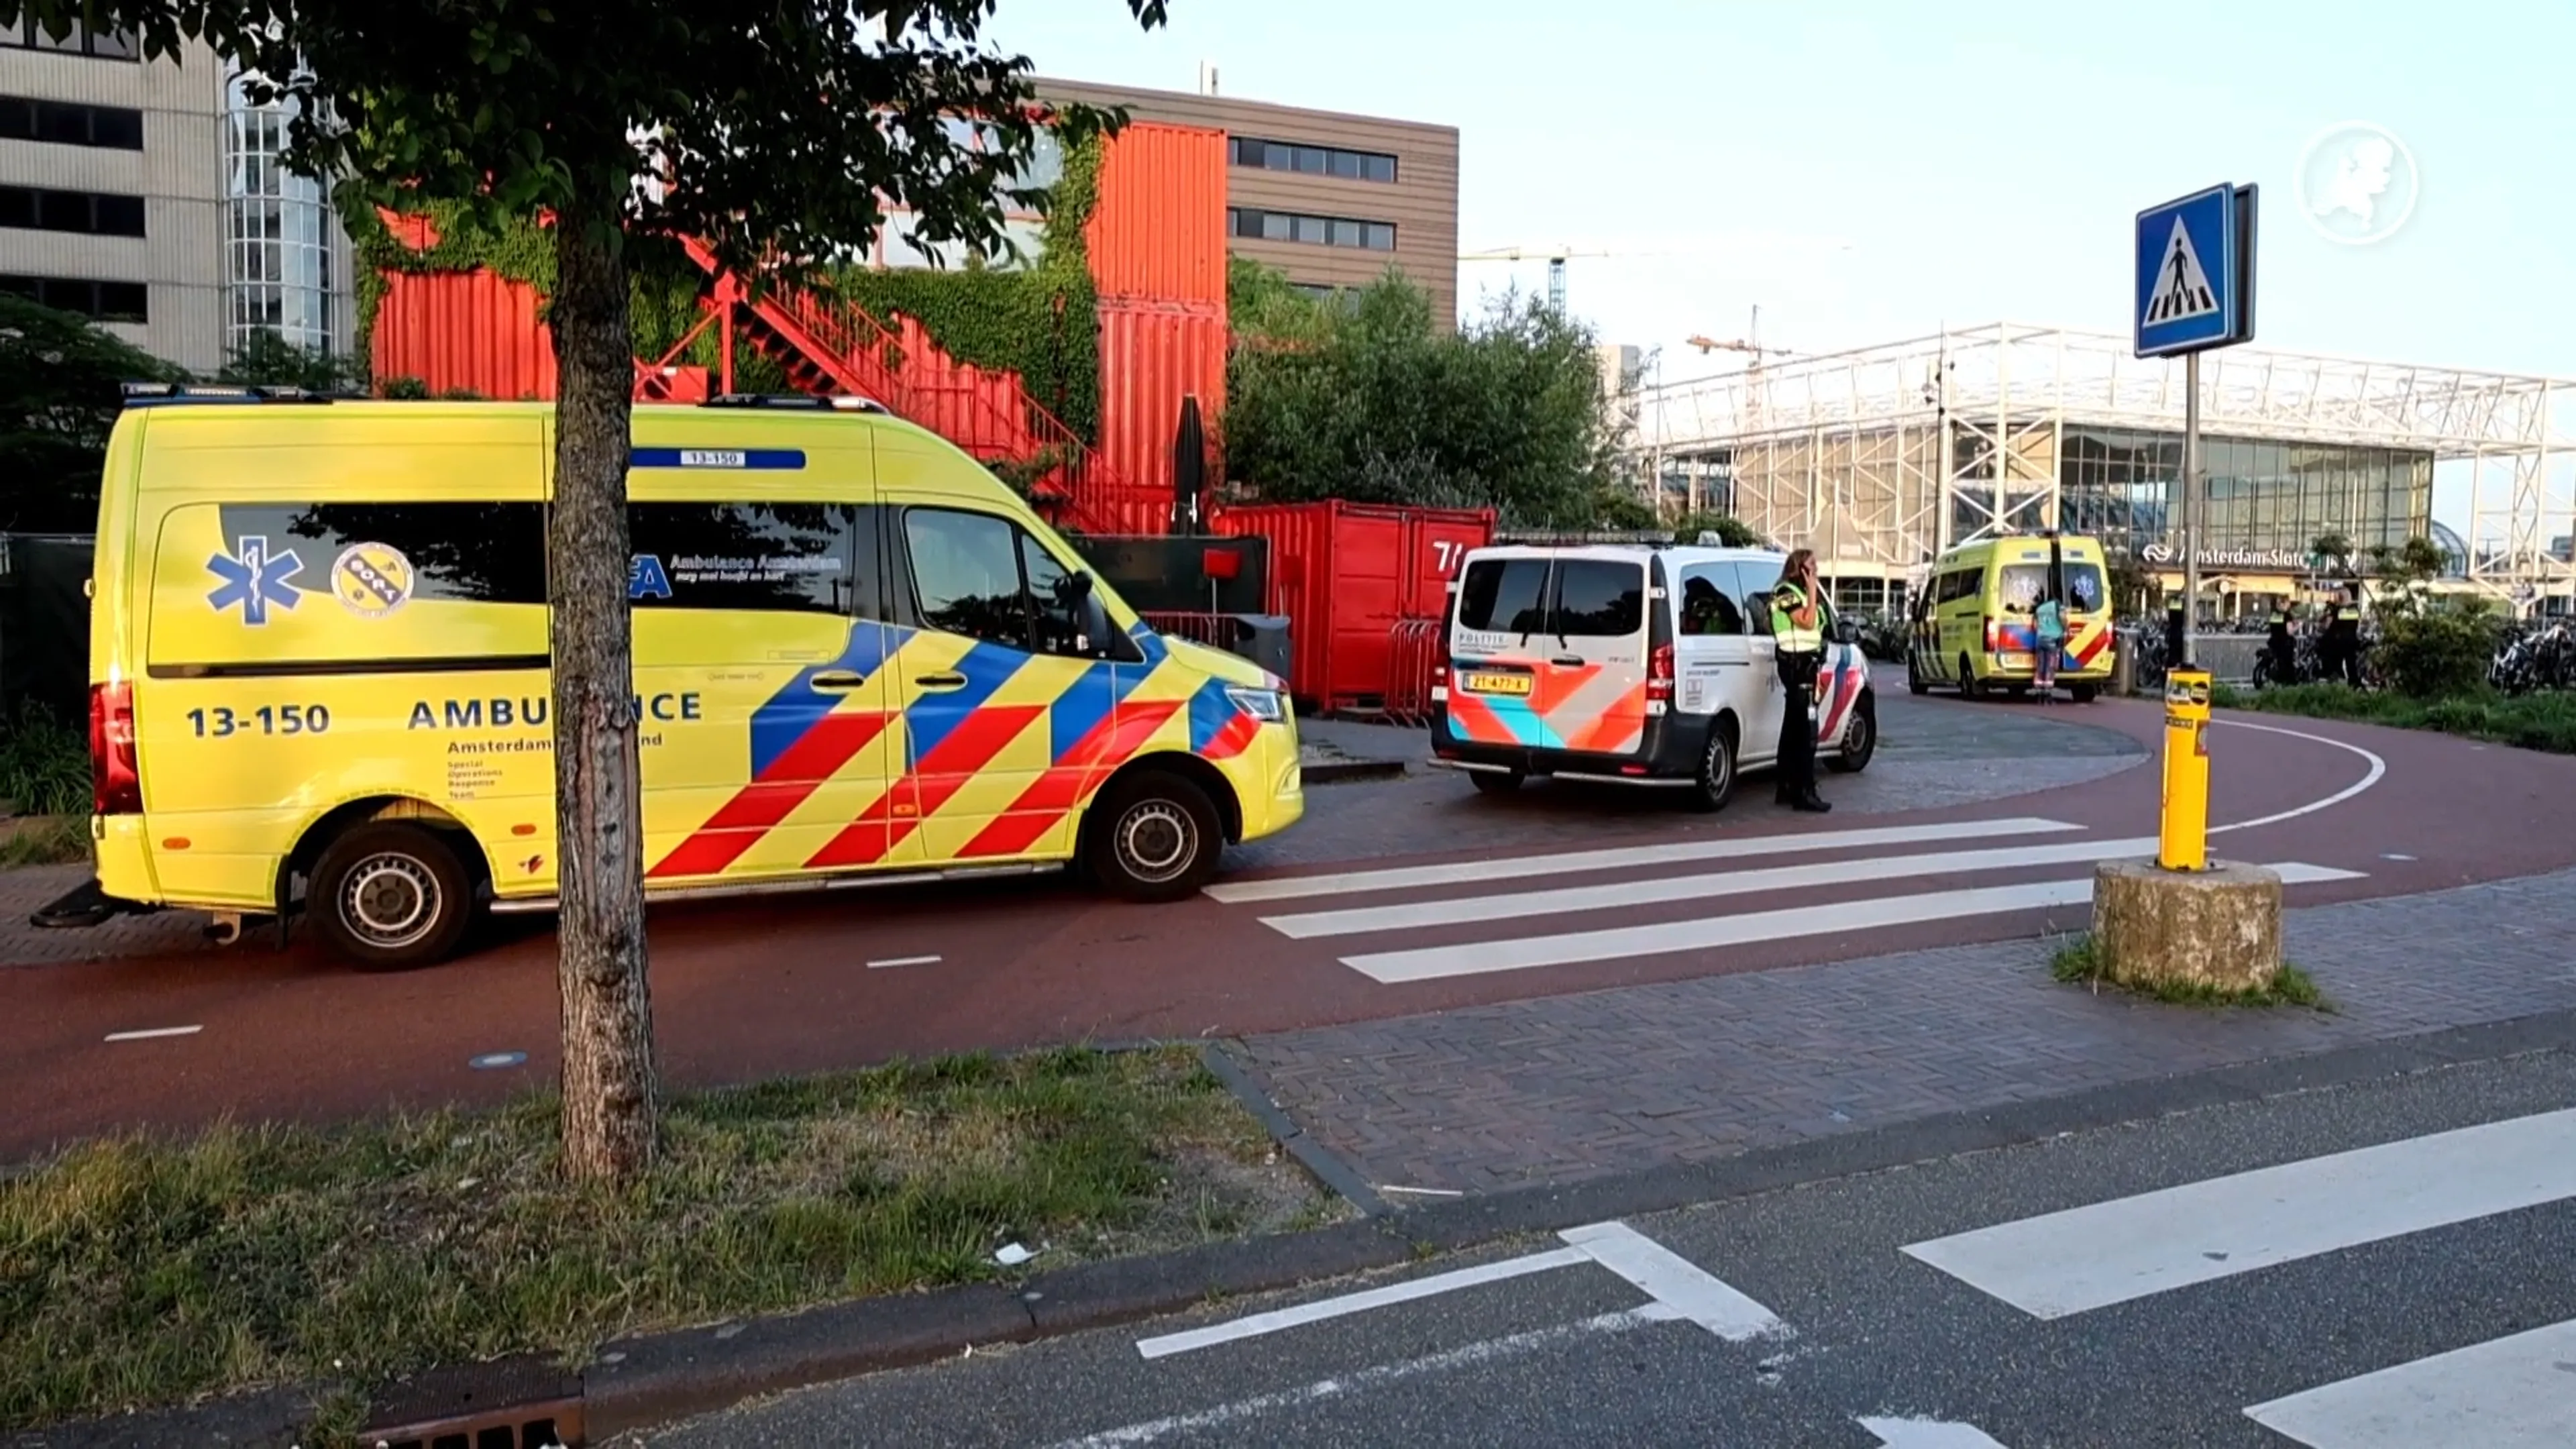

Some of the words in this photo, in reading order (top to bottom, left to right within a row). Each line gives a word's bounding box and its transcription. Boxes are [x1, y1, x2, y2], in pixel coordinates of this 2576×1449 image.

[692, 451, 738, 464] 13-150
[670, 554, 754, 570] Ambulance
[757, 554, 842, 571] Amsterdam
[187, 704, 329, 737] 13-150
[408, 693, 702, 731] AMBUNCE
